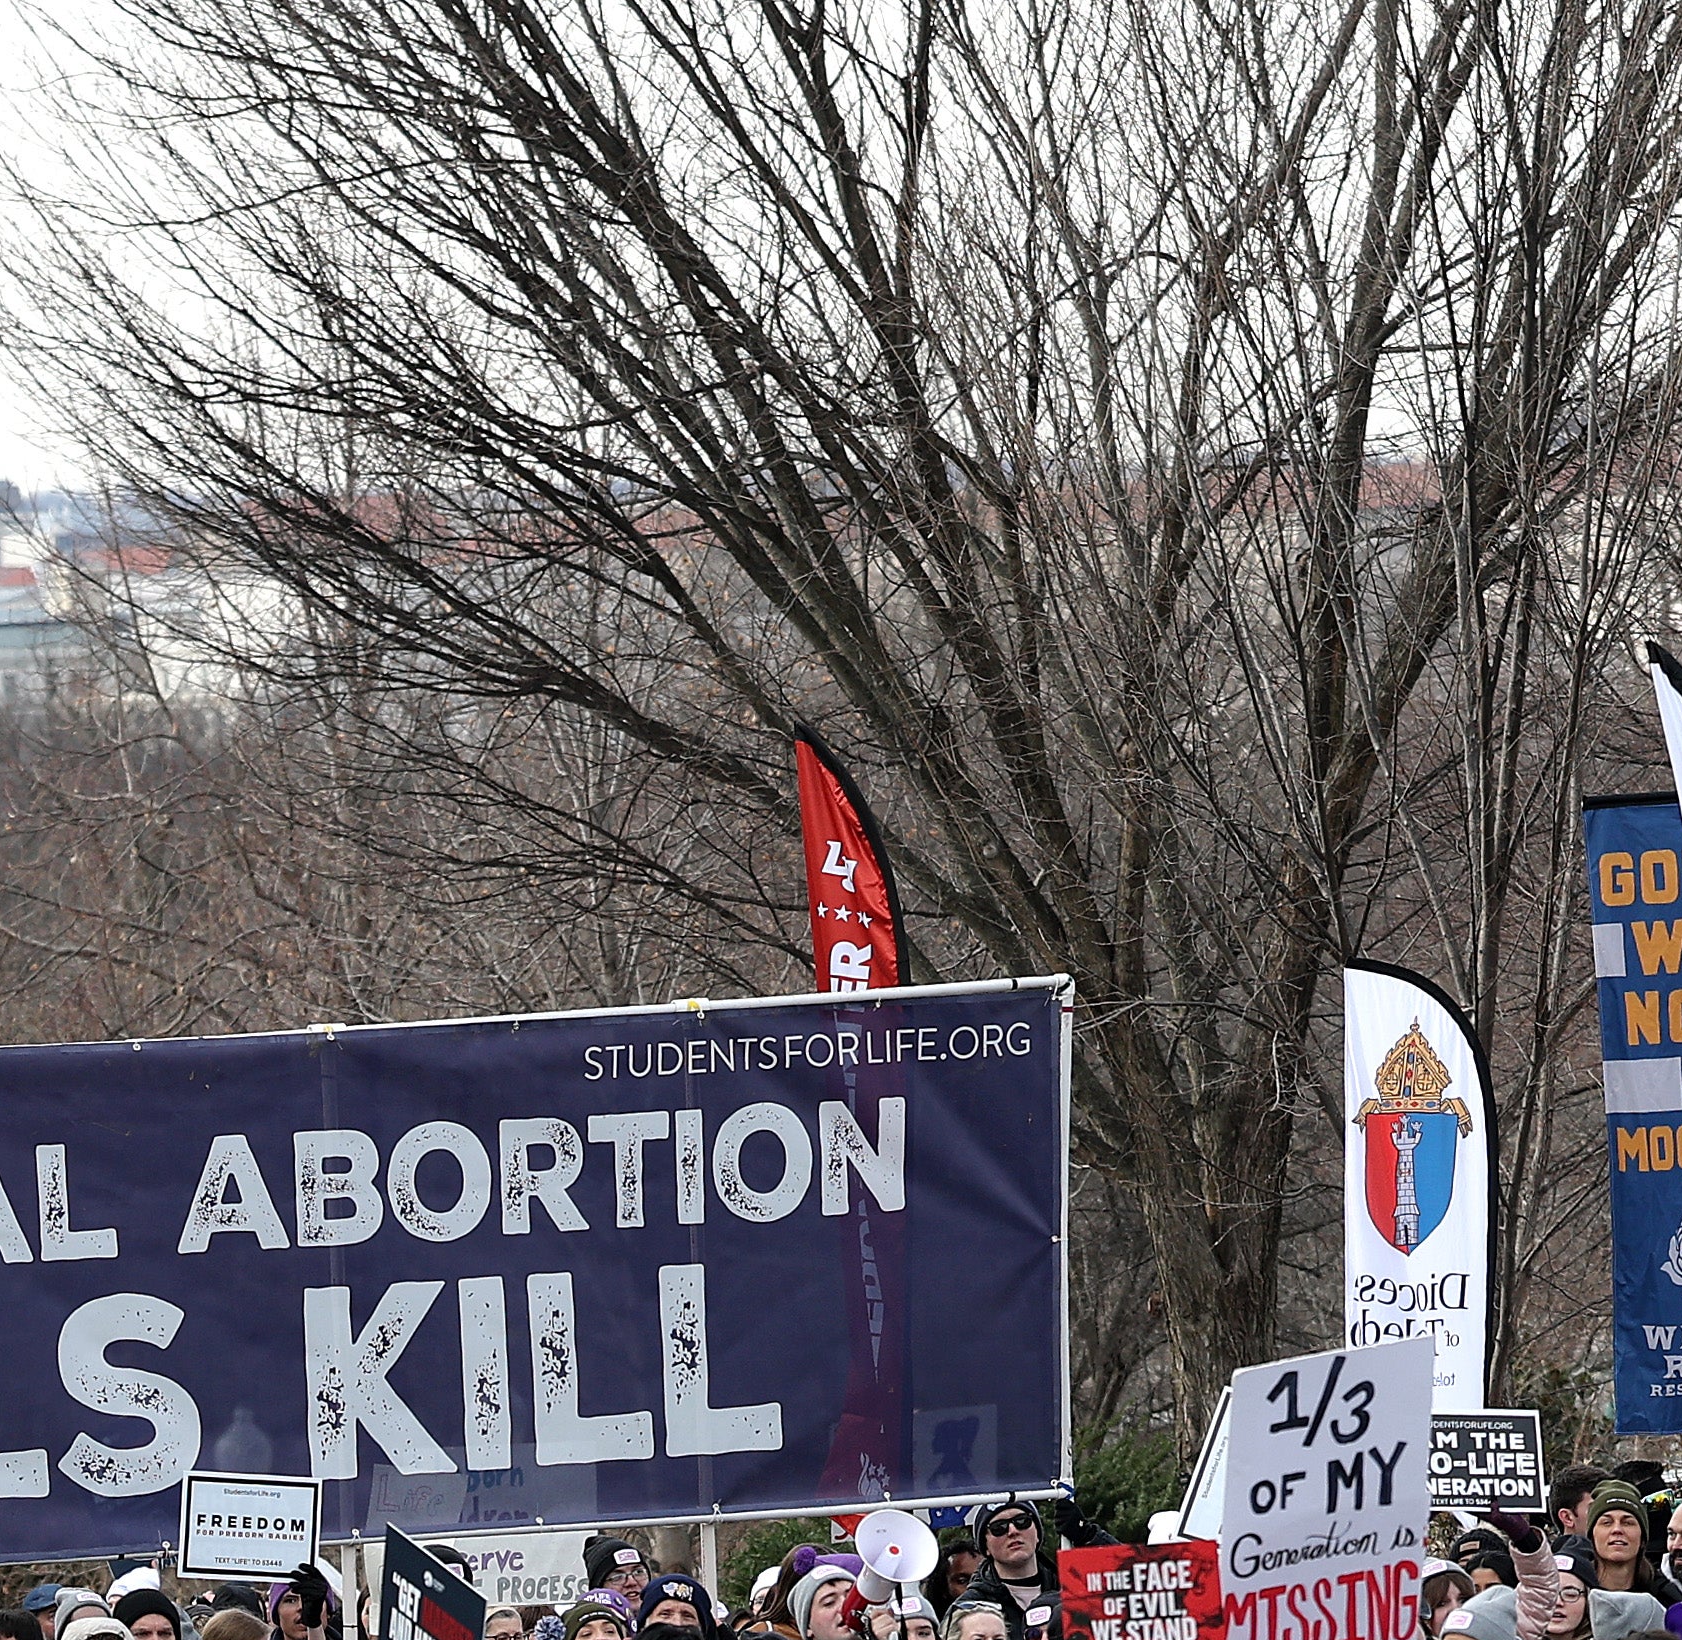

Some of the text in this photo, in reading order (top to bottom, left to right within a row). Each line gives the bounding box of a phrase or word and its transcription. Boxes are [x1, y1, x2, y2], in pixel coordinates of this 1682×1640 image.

[584, 1021, 1032, 1082] STUDENTSFORLIFE.ORG
[178, 1096, 907, 1254] ABORTION
[304, 1264, 783, 1480] KILL
[1267, 1356, 1374, 1446] 1/3
[1470, 1431, 1526, 1450] THE
[1250, 1442, 1407, 1515] OF MY
[1427, 1452, 1537, 1475] O-LIFE
[197, 1514, 305, 1532] FREEDOM
[269, 1533, 304, 1541] BABIES
[1231, 1523, 1416, 1578] Generation is
[1086, 1559, 1194, 1592] IN THE FACE
[1103, 1592, 1188, 1619] OF EVIL,
